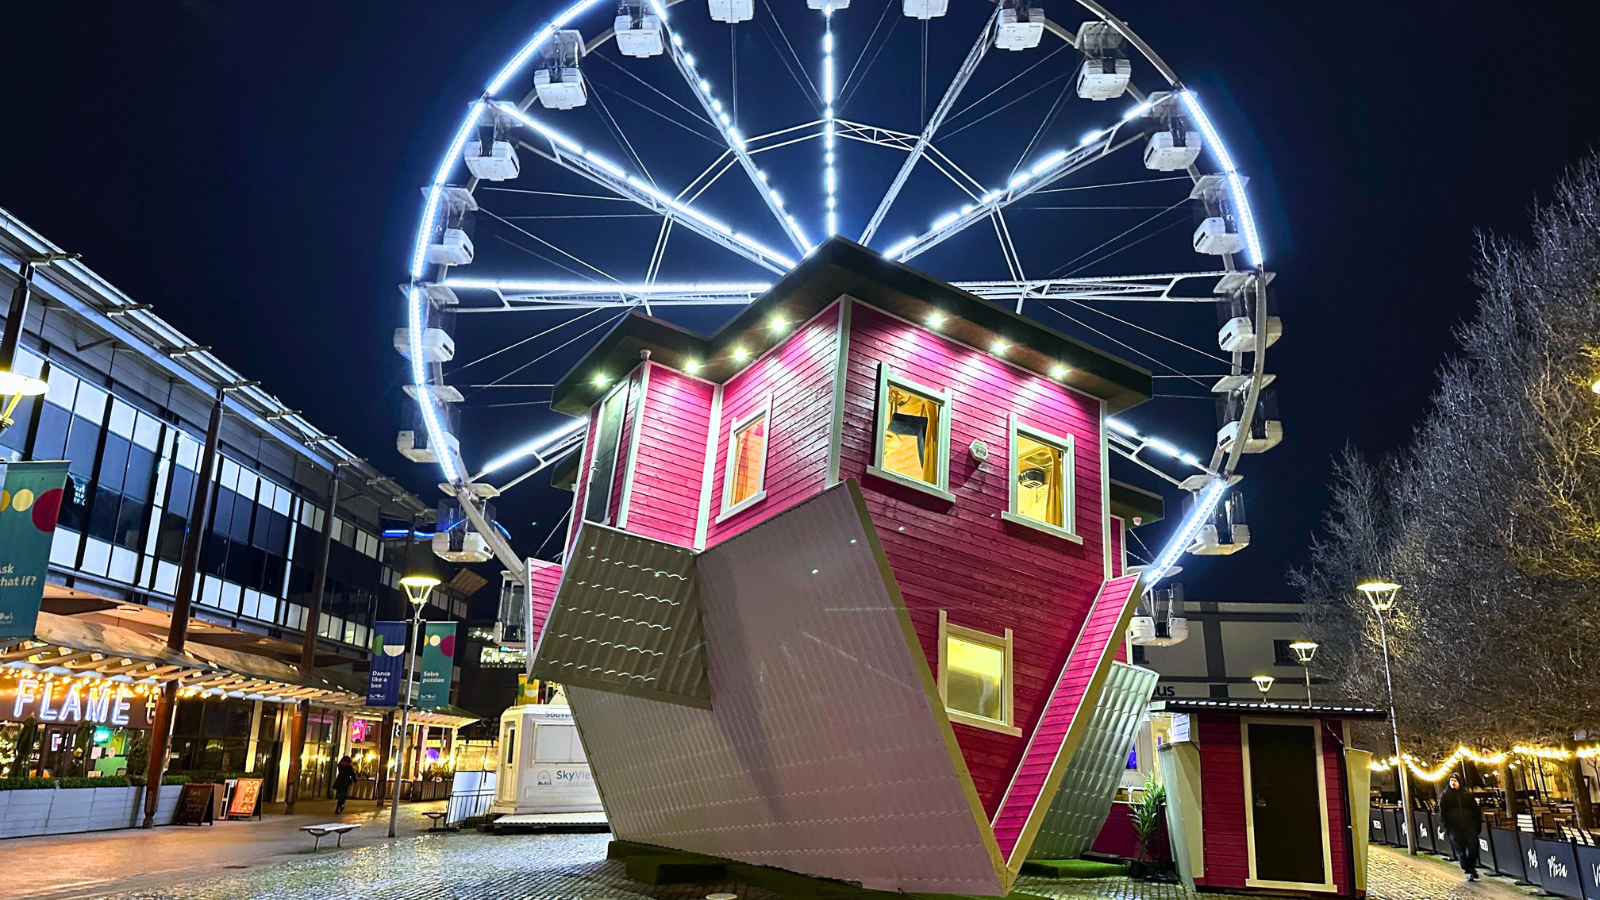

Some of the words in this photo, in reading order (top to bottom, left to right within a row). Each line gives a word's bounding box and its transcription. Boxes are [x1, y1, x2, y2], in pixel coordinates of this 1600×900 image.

[0, 576, 19, 586] hat
[21, 575, 37, 586] if?
[13, 678, 130, 725] FLAME
[556, 770, 591, 781] SkyVie
